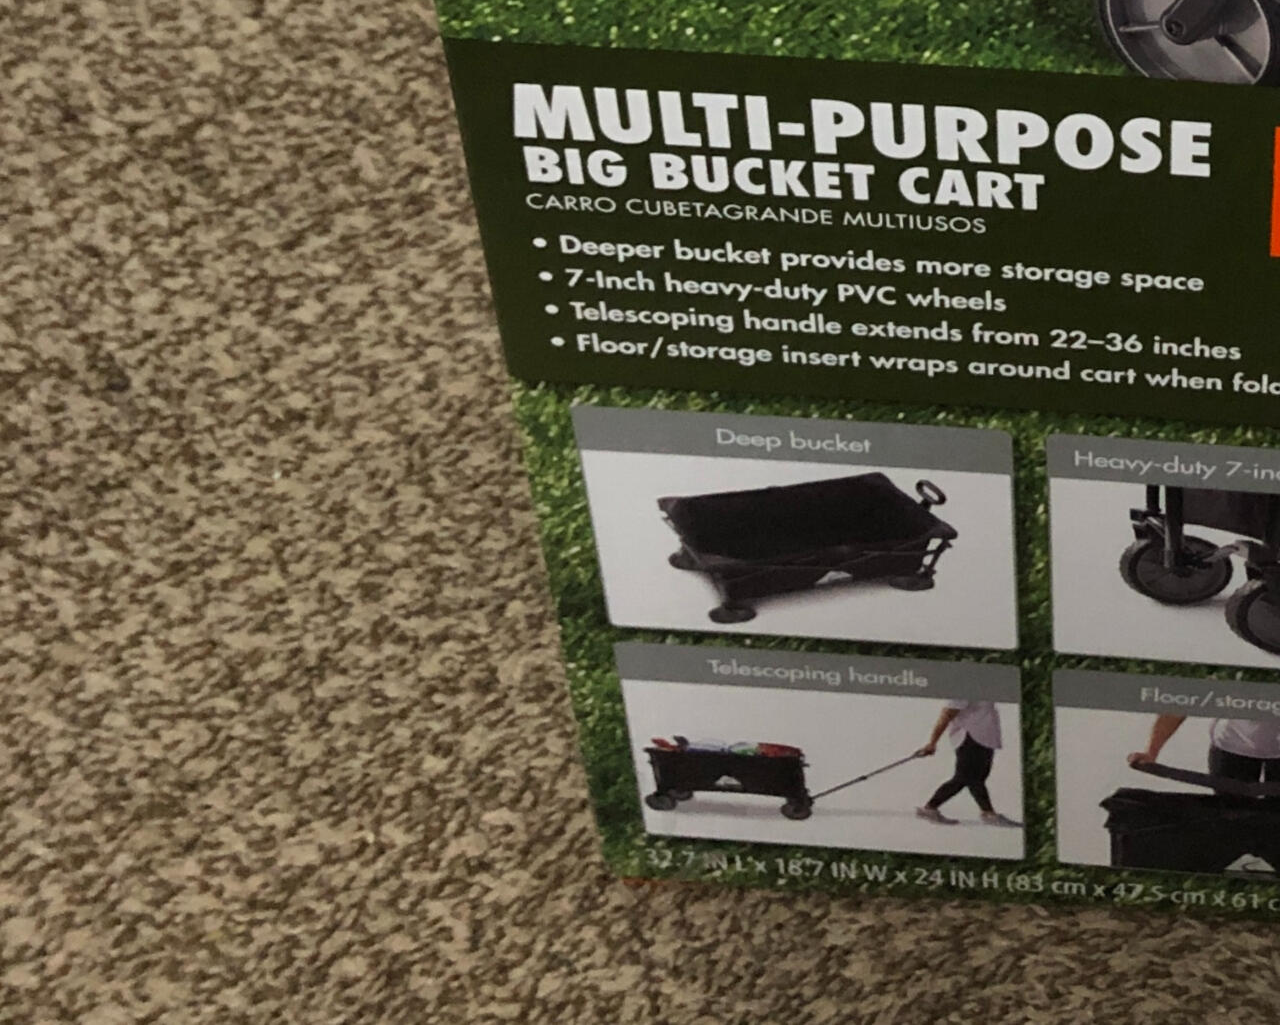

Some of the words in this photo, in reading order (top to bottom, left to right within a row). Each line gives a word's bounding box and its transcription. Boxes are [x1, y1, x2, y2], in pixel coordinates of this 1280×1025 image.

[512, 82, 1213, 178] MULTI-PURPOSE
[522, 145, 628, 188] BIG
[649, 152, 876, 201] BUCKET
[898, 167, 1046, 211] CART
[525, 192, 617, 213] CARRO
[625, 198, 833, 225] CUBETAGRANDE
[842, 211, 987, 235] MULTIUSOS
[559, 234, 665, 263] Deeper
[673, 239, 772, 265] bucket
[780, 248, 906, 274] provides
[916, 259, 992, 278] more
[1001, 261, 1111, 289] storage
[1120, 271, 1205, 293] space
[564, 268, 656, 292] 7-Inch
[664, 271, 828, 307] heavy-duty
[837, 282, 897, 306] PVC
[905, 287, 1007, 312] wheels
[568, 301, 735, 333] Telescoping
[743, 309, 843, 336] handle
[851, 320, 963, 343] extends
[971, 322, 1040, 347] from
[1152, 335, 1242, 361] inches
[575, 332, 773, 367] Floor/storage
[782, 345, 862, 368] insert
[869, 355, 959, 378] wraps
[967, 360, 1071, 381] around
[1079, 368, 1137, 386] cart
[1144, 368, 1224, 392] when
[715, 427, 782, 451] Deep
[790, 429, 872, 454] bucket
[1074, 449, 1217, 480] Heavy-duty
[706, 658, 842, 687] Telescoping
[848, 662, 929, 688] handle
[754, 860, 768, 874] x
[774, 857, 824, 877] 18.7
[832, 861, 858, 879] IN
[862, 864, 888, 882] W
[894, 870, 909, 885] x
[914, 868, 945, 886] 24
[951, 869, 976, 887] IN
[982, 873, 999, 890] H
[1006, 874, 1044, 894] (83
[1052, 880, 1086, 896] cm
[1093, 882, 1106, 897] x
[1170, 888, 1206, 905] cm
[1211, 893, 1226, 908] x
[1231, 891, 1260, 909] 61
